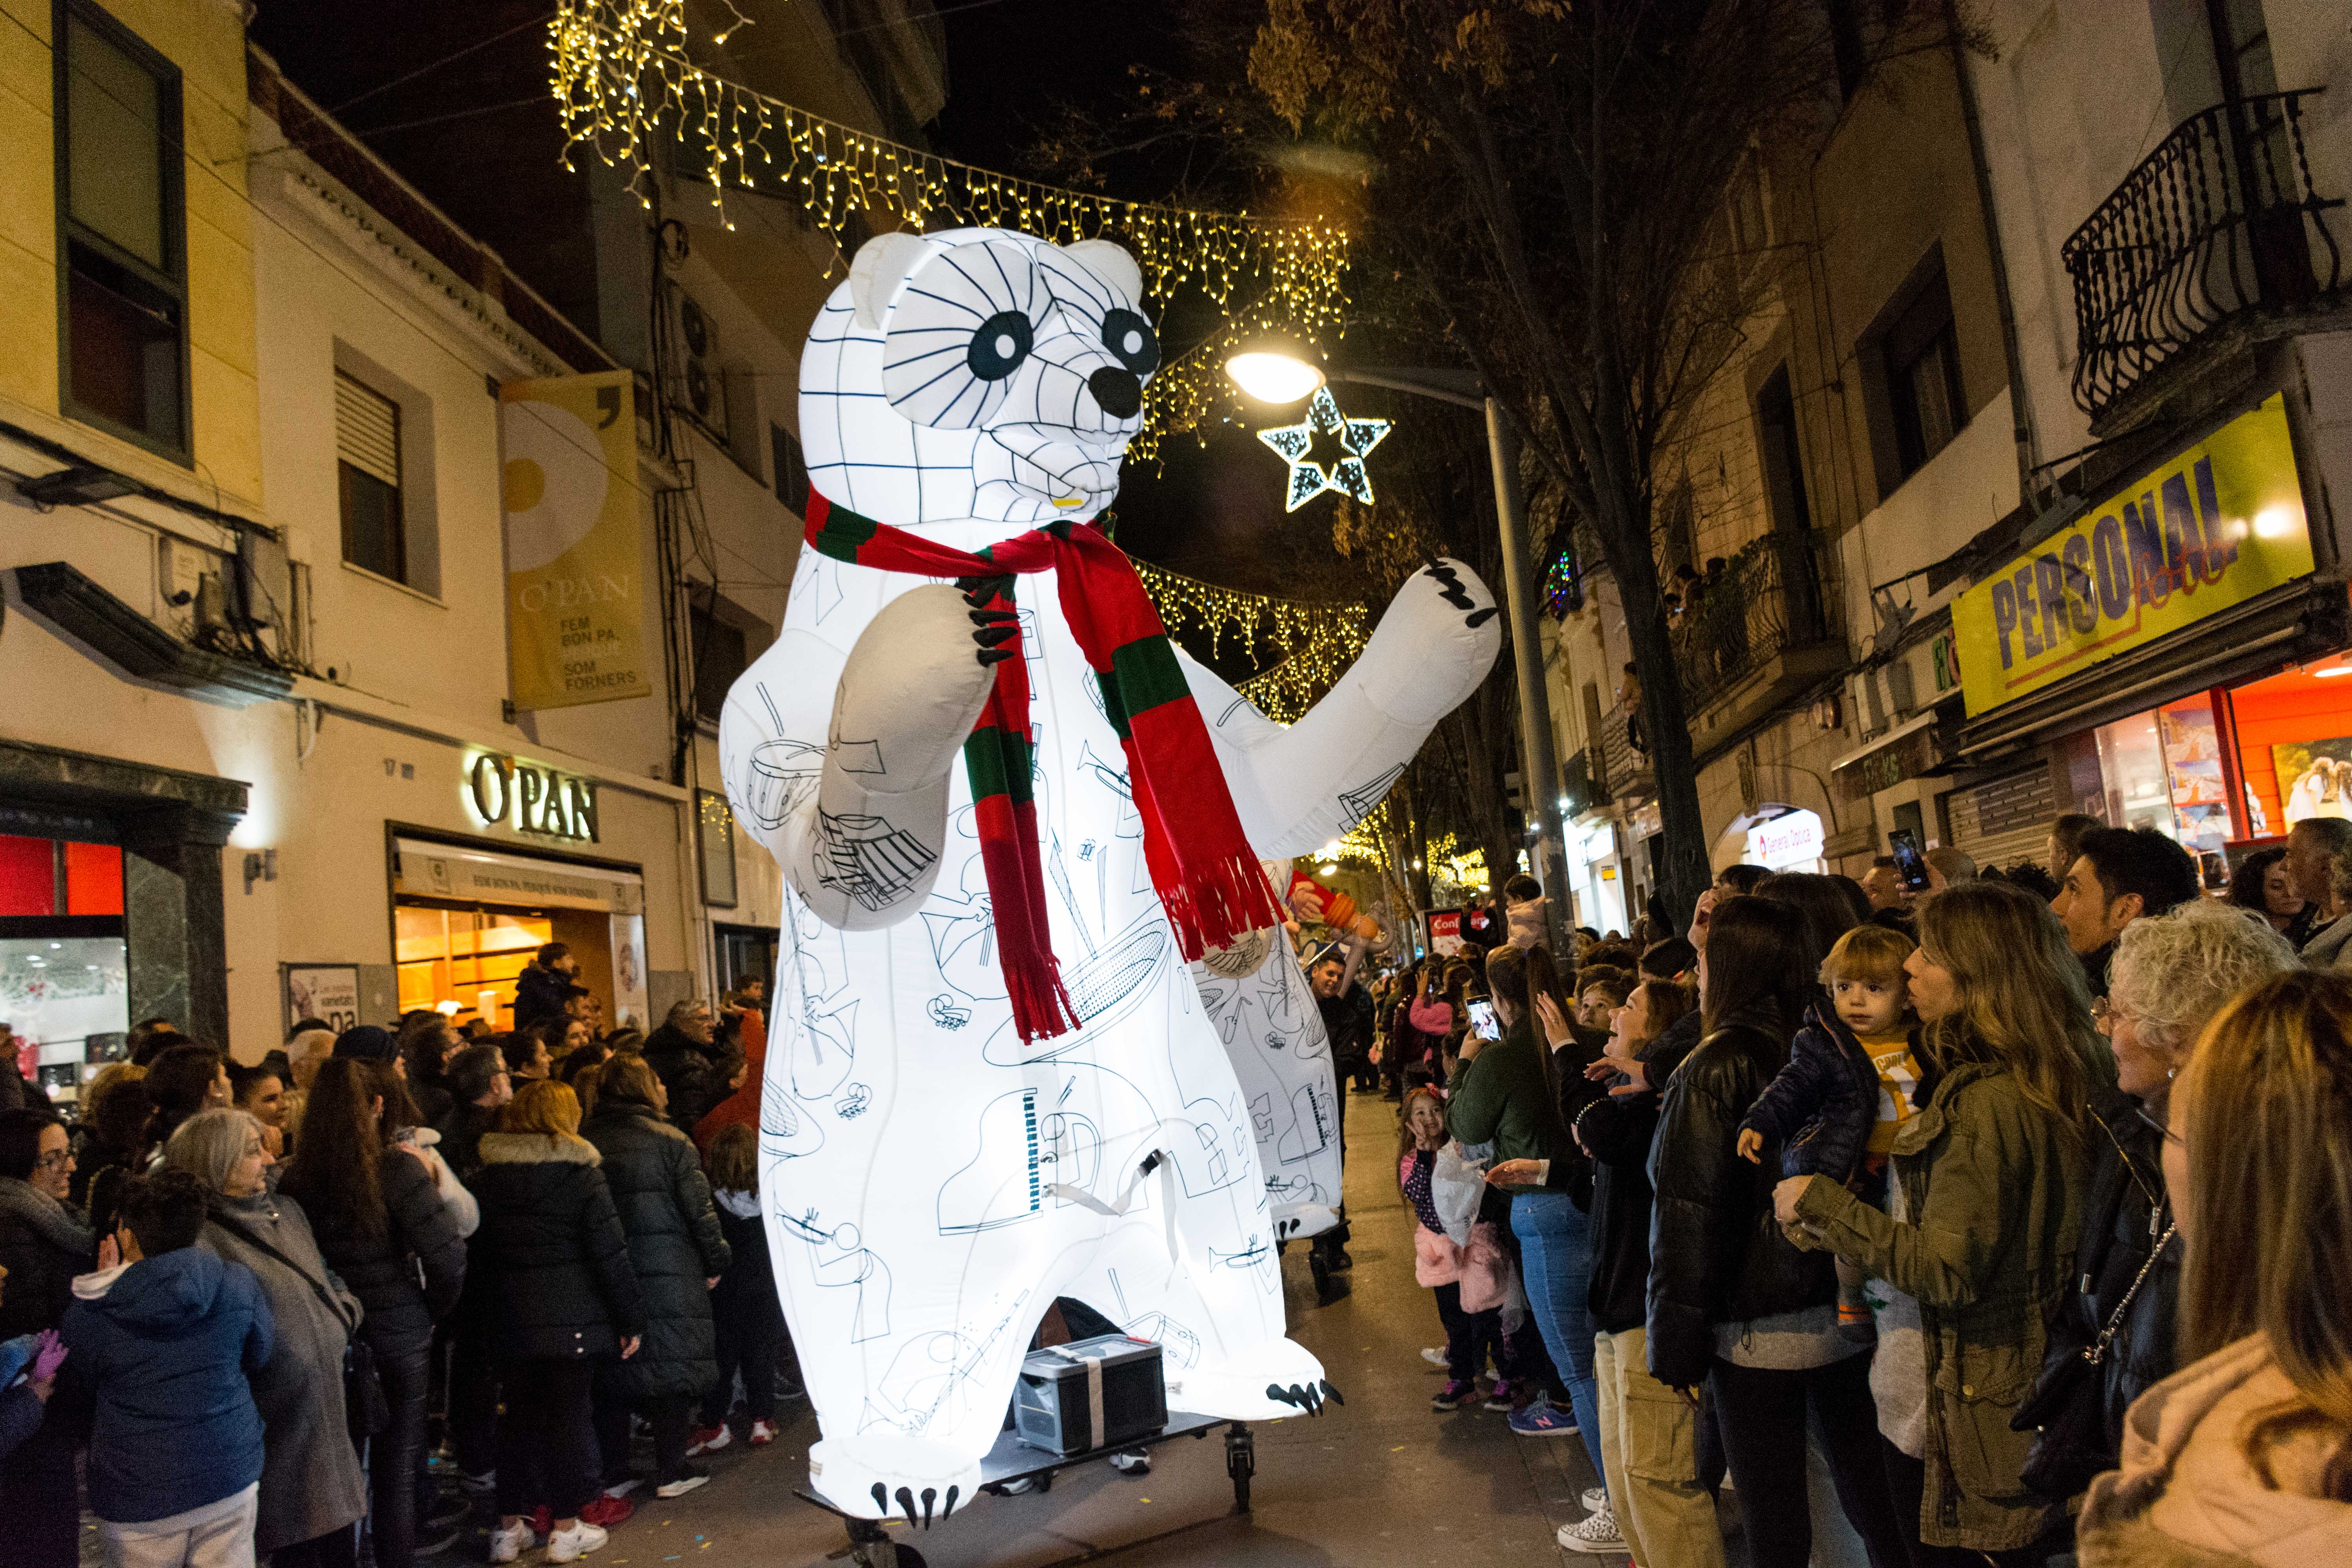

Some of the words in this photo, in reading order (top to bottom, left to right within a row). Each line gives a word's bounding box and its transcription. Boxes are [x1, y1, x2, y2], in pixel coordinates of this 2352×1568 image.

[1992, 455, 2238, 670] PERSONAL
[521, 575, 630, 612] O'PAN
[2131, 540, 2236, 632] foto
[561, 616, 590, 632] FEM
[561, 632, 592, 647] BON
[564, 660, 596, 676] SOM
[565, 671, 636, 690] FORNERS
[472, 752, 599, 843] O'PAN
